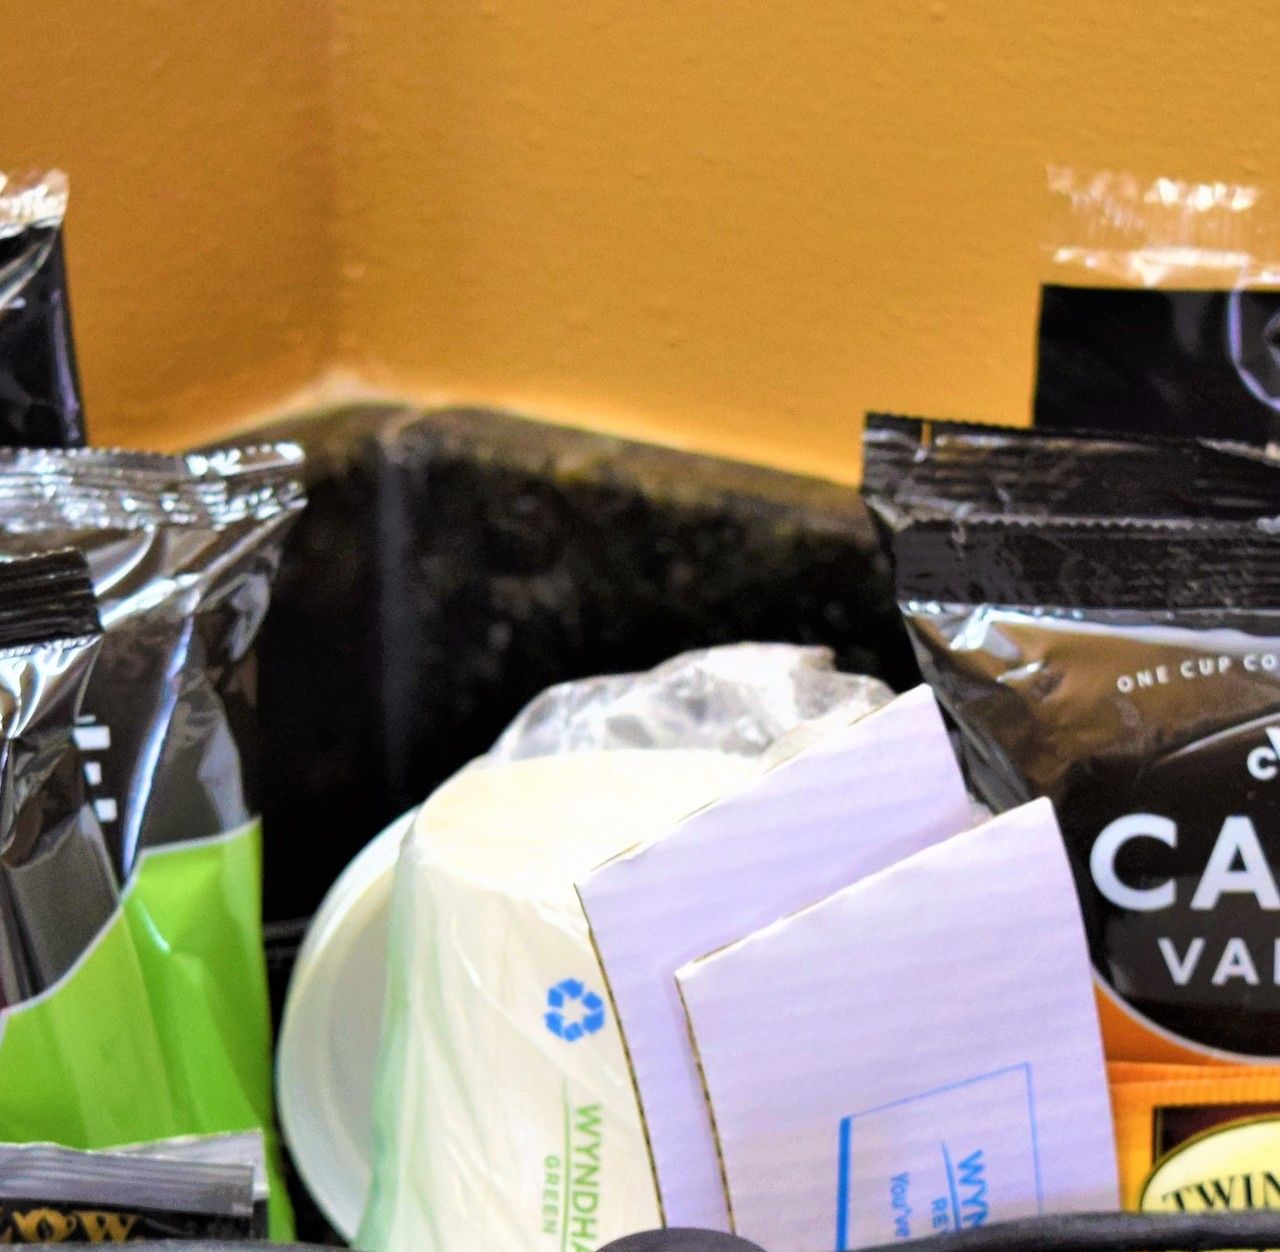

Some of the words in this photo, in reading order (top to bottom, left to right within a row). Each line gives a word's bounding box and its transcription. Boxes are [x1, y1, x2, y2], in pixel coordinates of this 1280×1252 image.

[1117, 665, 1169, 693] ONE
[1180, 656, 1231, 679] CUP
[541, 1153, 561, 1235] GREEN
